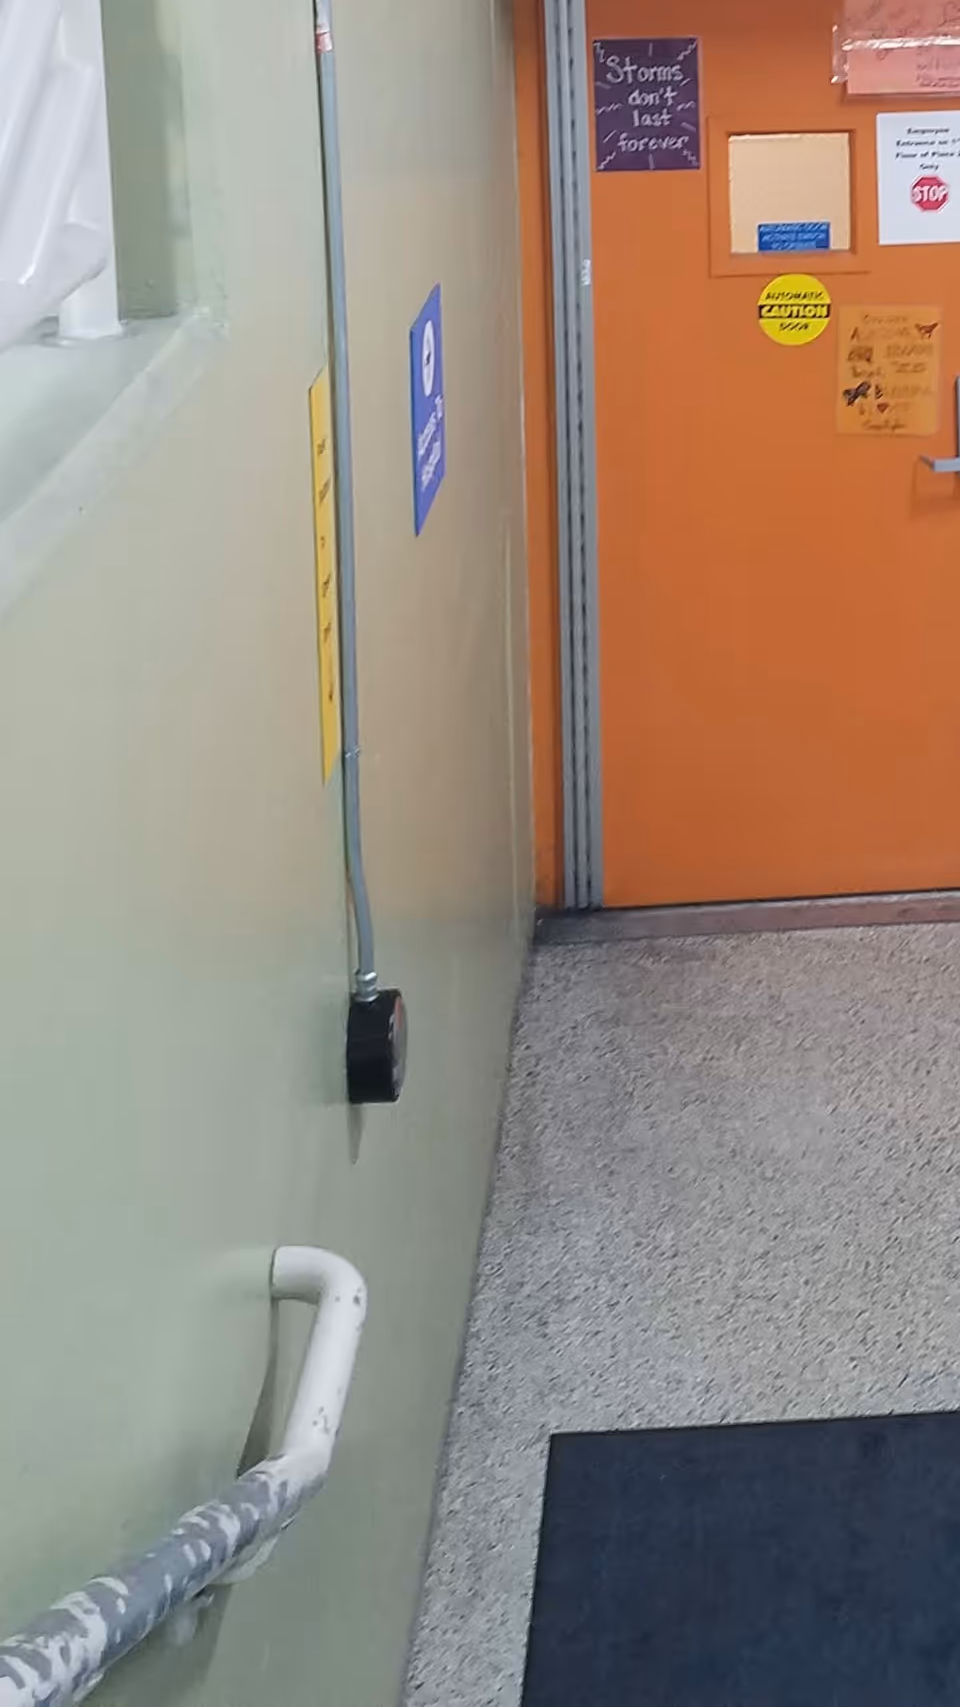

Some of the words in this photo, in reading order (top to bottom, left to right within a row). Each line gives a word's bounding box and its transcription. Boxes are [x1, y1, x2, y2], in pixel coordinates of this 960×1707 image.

[606, 55, 684, 84] Storms
[628, 85, 678, 106] don't
[633, 108, 673, 127] last
[618, 132, 689, 151] forever
[911, 185, 948, 203] STOP
[765, 291, 824, 301] AUTOMATIC
[760, 304, 829, 318] CAUTION
